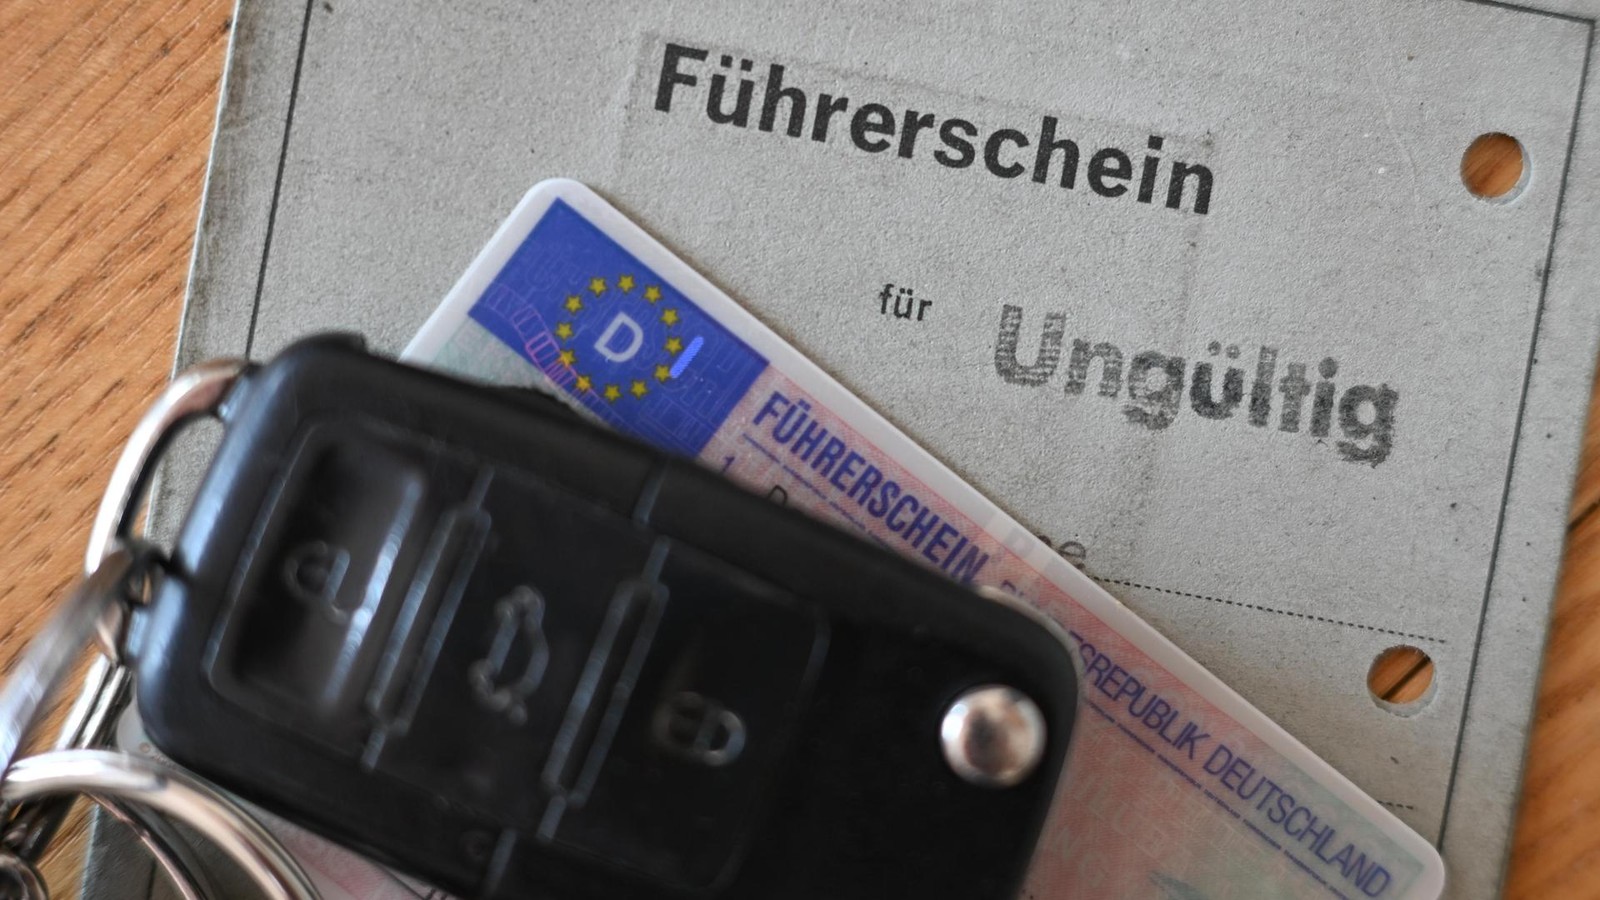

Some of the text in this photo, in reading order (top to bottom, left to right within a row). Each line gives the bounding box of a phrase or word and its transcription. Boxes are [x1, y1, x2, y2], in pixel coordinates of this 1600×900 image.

[654, 42, 1214, 215] Führerschein
[593, 311, 644, 363] D
[879, 283, 933, 322] für
[994, 303, 1399, 466] Ungültig
[752, 390, 990, 587] FÜHRERSCHEIN
[1202, 744, 1393, 900] DEUTSCHLAND
